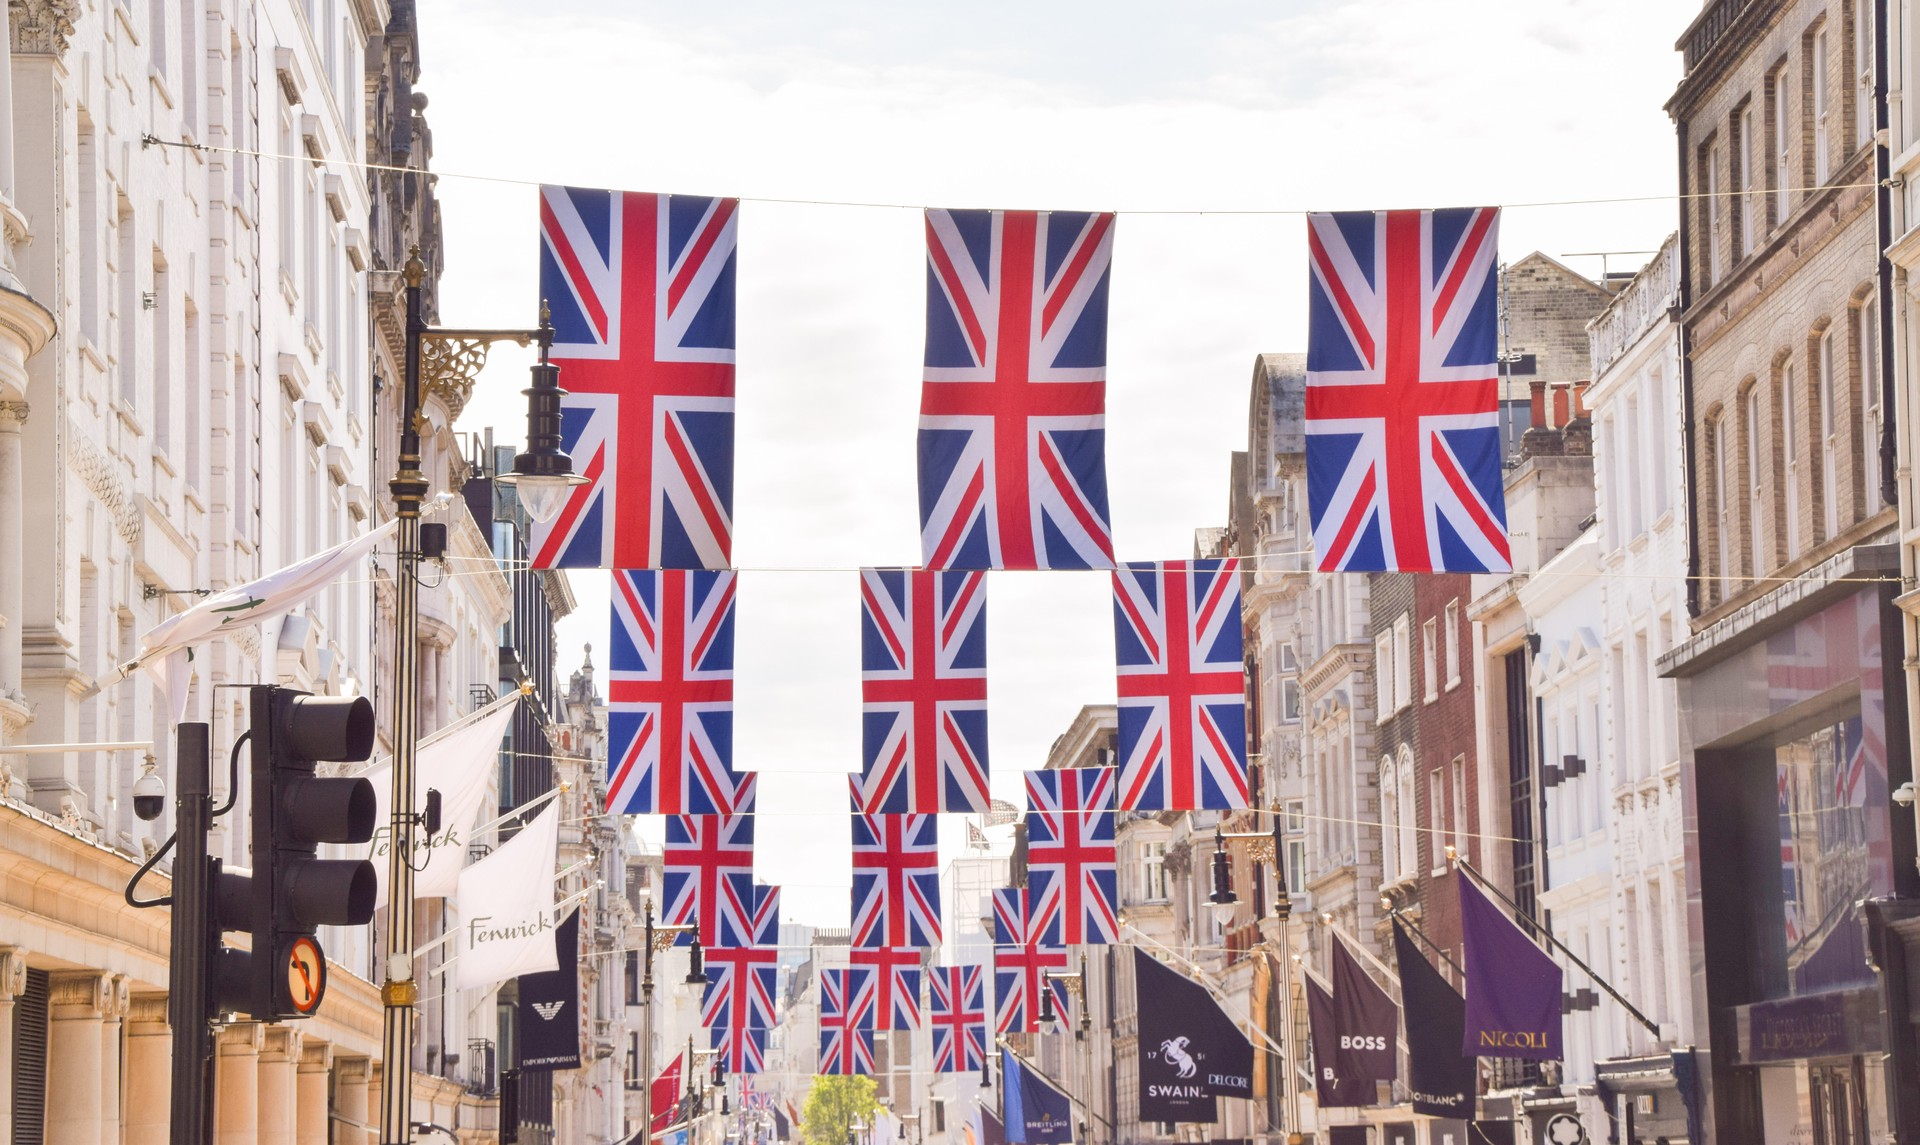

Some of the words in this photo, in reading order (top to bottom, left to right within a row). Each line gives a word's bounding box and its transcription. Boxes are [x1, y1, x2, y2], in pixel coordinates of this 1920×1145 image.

[467, 911, 552, 950] Fenwick
[1340, 1035, 1387, 1051] BOSS
[1480, 1030, 1548, 1049] NICOLI
[1147, 1051, 1157, 1060] 17
[1026, 1119, 1068, 1129] BREITLING
